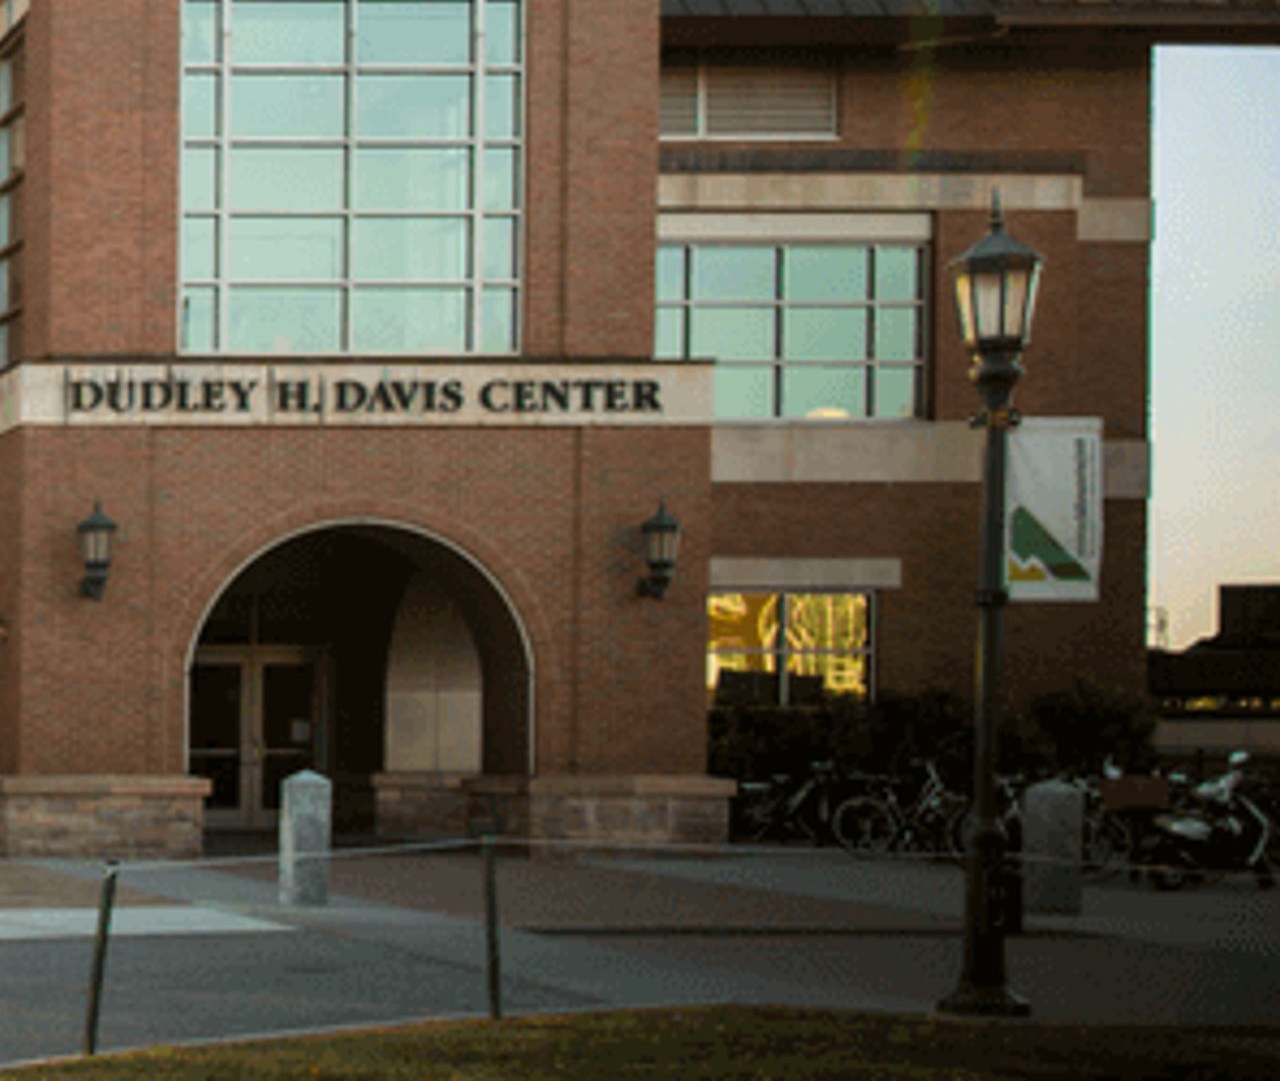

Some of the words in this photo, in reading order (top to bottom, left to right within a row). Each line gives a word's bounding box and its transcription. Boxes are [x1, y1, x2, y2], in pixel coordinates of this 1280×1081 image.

[70, 380, 256, 412] DUDLEY
[276, 381, 321, 412] H.
[335, 380, 463, 412] DAVIS
[479, 380, 662, 412] CENTER
